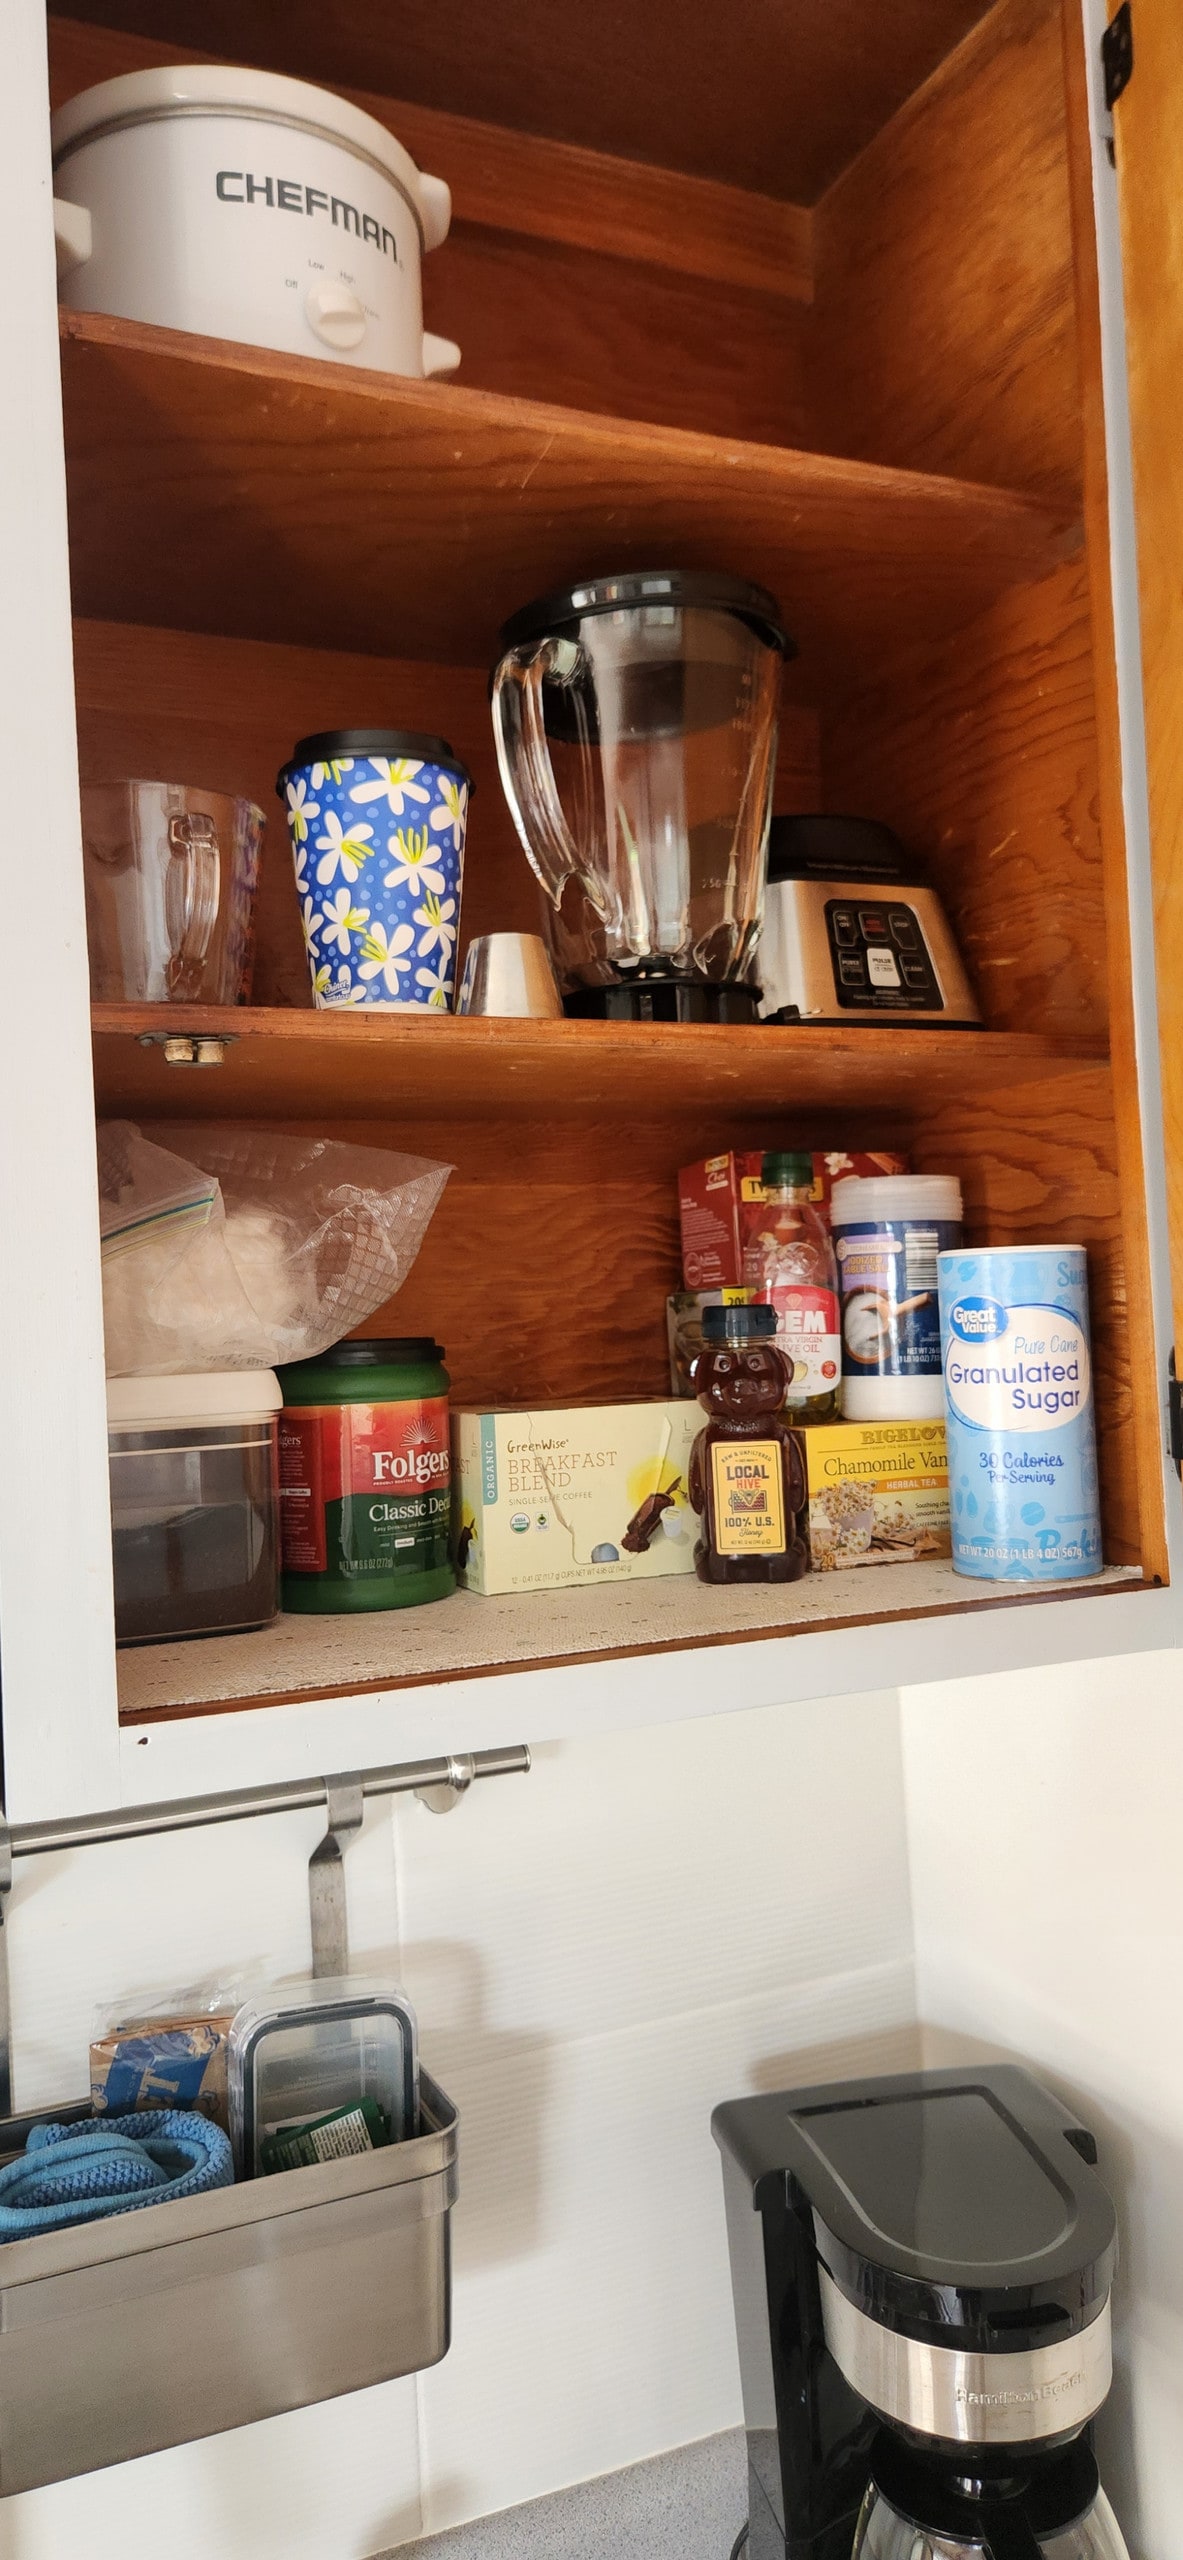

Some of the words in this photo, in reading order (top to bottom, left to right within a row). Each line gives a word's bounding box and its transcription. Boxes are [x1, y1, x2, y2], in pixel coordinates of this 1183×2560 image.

[216, 171, 398, 264] CHEFMAN
[308, 259, 325, 270] Low
[285, 279, 298, 289] Off
[953, 1306, 996, 1324] Great
[961, 1321, 997, 1333] Value
[803, 1344, 820, 1352] OIL
[1014, 1336, 1045, 1355] Pure
[1050, 1335, 1078, 1353] Cane
[950, 1360, 1079, 1384] Granulated
[1012, 1388, 1080, 1414] Sugar
[507, 1438, 568, 1453] GreenWise
[508, 1451, 617, 1475] BREAKFAST
[740, 1450, 772, 1462] UNFILTERED
[979, 1452, 999, 1469] 30
[1003, 1451, 1065, 1469] Calories
[372, 1449, 449, 1484] Folgers
[486, 1441, 496, 1499] ORGANIC
[824, 1452, 916, 1476] Chamomile
[726, 1465, 770, 1480] LOCAL
[987, 1470, 1009, 1483] Per
[1009, 1470, 1056, 1485] Serving
[509, 1472, 571, 1492] BLEND
[736, 1479, 762, 1489] HIVE
[886, 1480, 919, 1490] HERBAL
[921, 1478, 937, 1487] TEA
[509, 1497, 537, 1506] SINGLE
[539, 1495, 561, 1504] SEE
[562, 1491, 593, 1501] COFFEE
[369, 1500, 426, 1522] Classic
[725, 1517, 752, 1528] 100%
[755, 1516, 775, 1526] U.S.
[739, 1528, 763, 1537] Honey
[958, 1544, 970, 1556] NET
[970, 1545, 983, 1557] WT
[983, 1546, 994, 1558] 20
[996, 1547, 1009, 1559] OZ
[1022, 1548, 1034, 1559] LB
[1036, 1548, 1043, 1559] 4
[1044, 1547, 1060, 1559] OZ)
[1061, 1546, 1083, 1560] 567g
[821, 1555, 834, 1565] 20
[957, 2388, 1039, 2406] Hamilton
[1041, 2370, 1087, 2399] Beach
